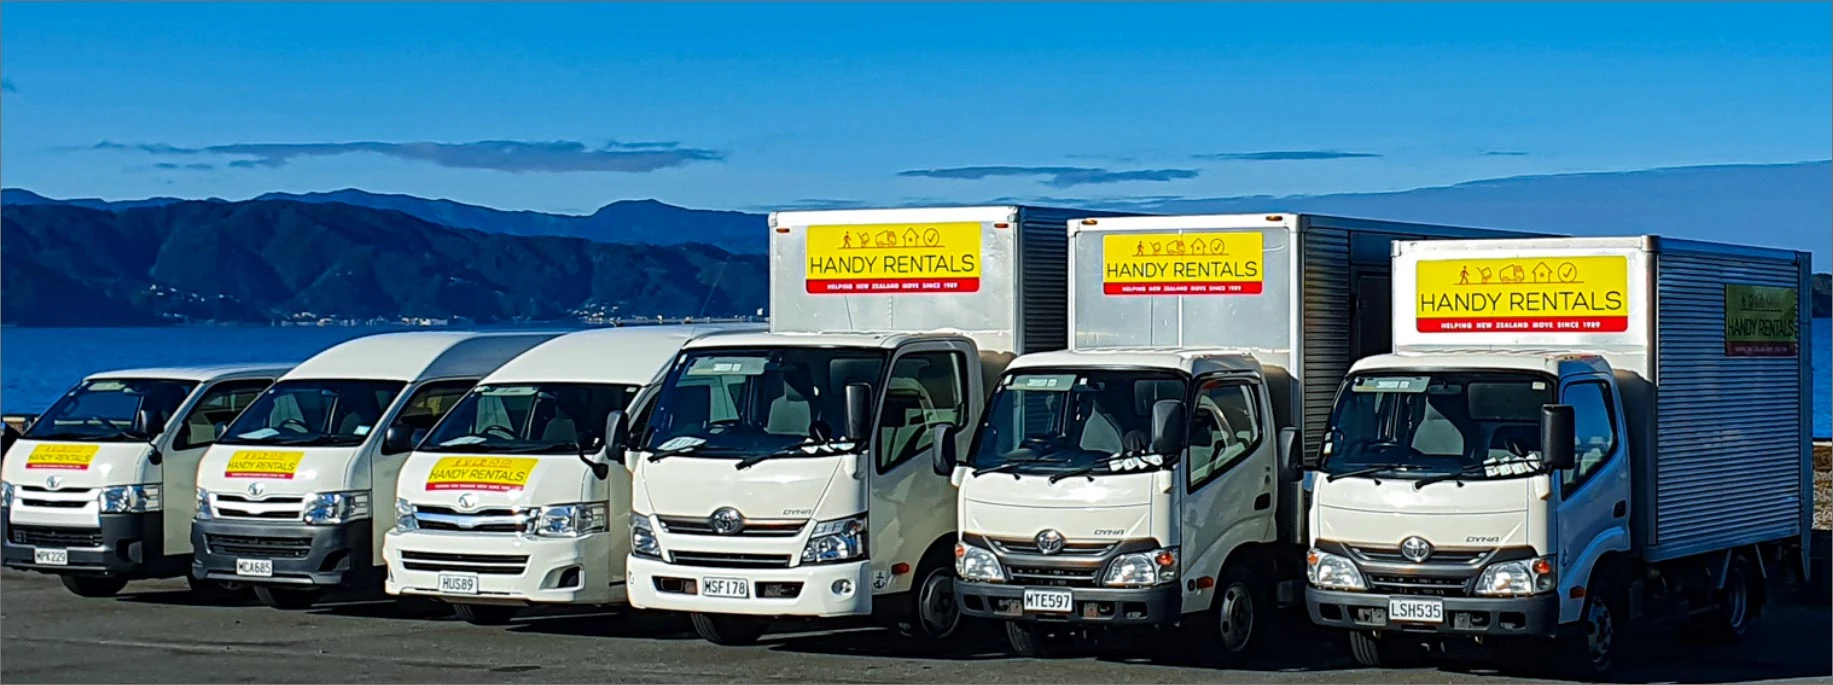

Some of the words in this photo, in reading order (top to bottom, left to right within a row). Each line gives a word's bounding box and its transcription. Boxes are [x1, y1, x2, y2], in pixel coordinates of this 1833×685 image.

[810, 255, 878, 274] HANDY
[884, 253, 975, 273] RENTALS
[1107, 261, 1168, 278] HANDY
[1174, 260, 1258, 277] RENTALS
[1420, 292, 1502, 312] HANDY
[1510, 290, 1622, 311] RENTALS
[1727, 317, 1758, 337] HANDY
[1759, 318, 1795, 337] RENTALS
[227, 461, 256, 470] HANDY
[256, 461, 297, 471] RENTALS
[429, 469, 469, 480] HANDY
[469, 469, 526, 481] RENTALS
[239, 561, 272, 574] MCA685
[442, 577, 473, 591] HUS89
[704, 580, 746, 595] MSF178
[1026, 593, 1070, 609] MTE597
[1391, 602, 1441, 619] LSH535
